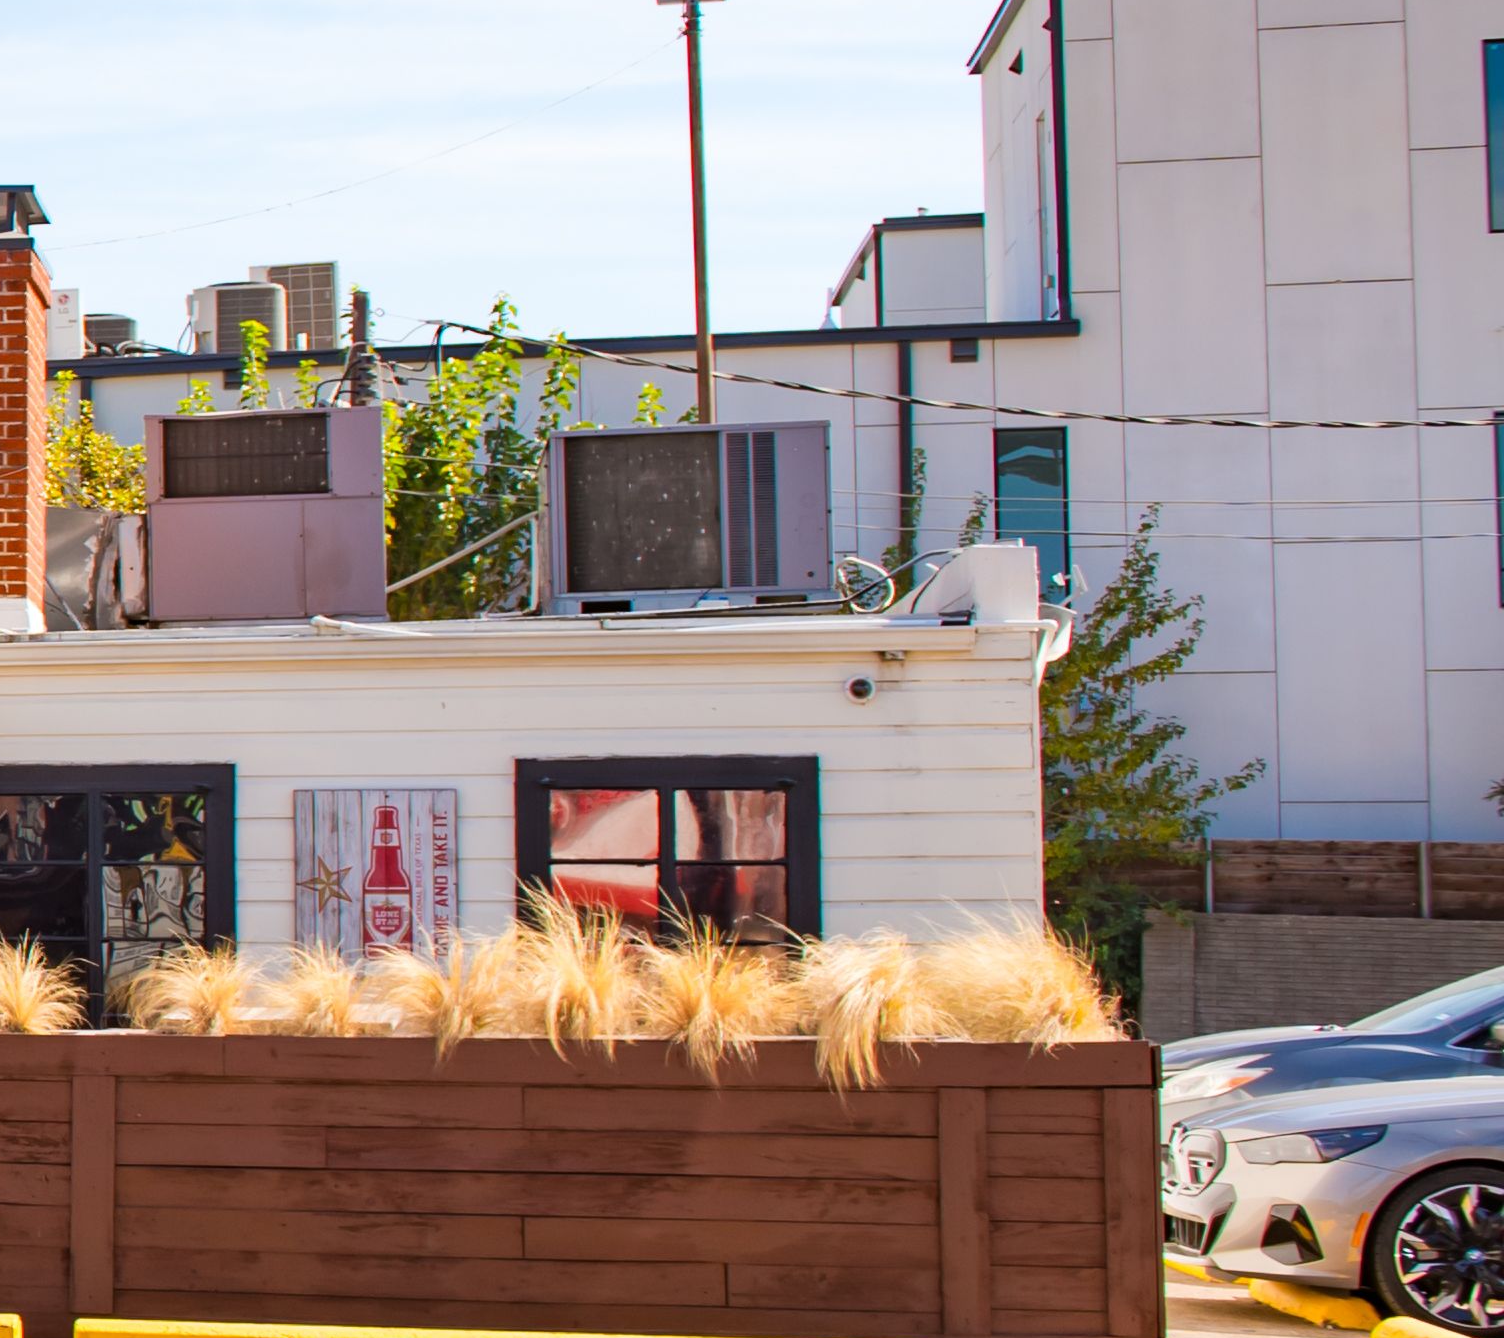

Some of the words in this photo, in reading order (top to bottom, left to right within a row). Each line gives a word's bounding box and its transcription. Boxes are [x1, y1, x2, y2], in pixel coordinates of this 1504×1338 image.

[433, 811, 448, 828] IT.
[414, 833, 423, 854] TEXAS
[433, 833, 448, 868] TAKE
[434, 875, 449, 908] AND
